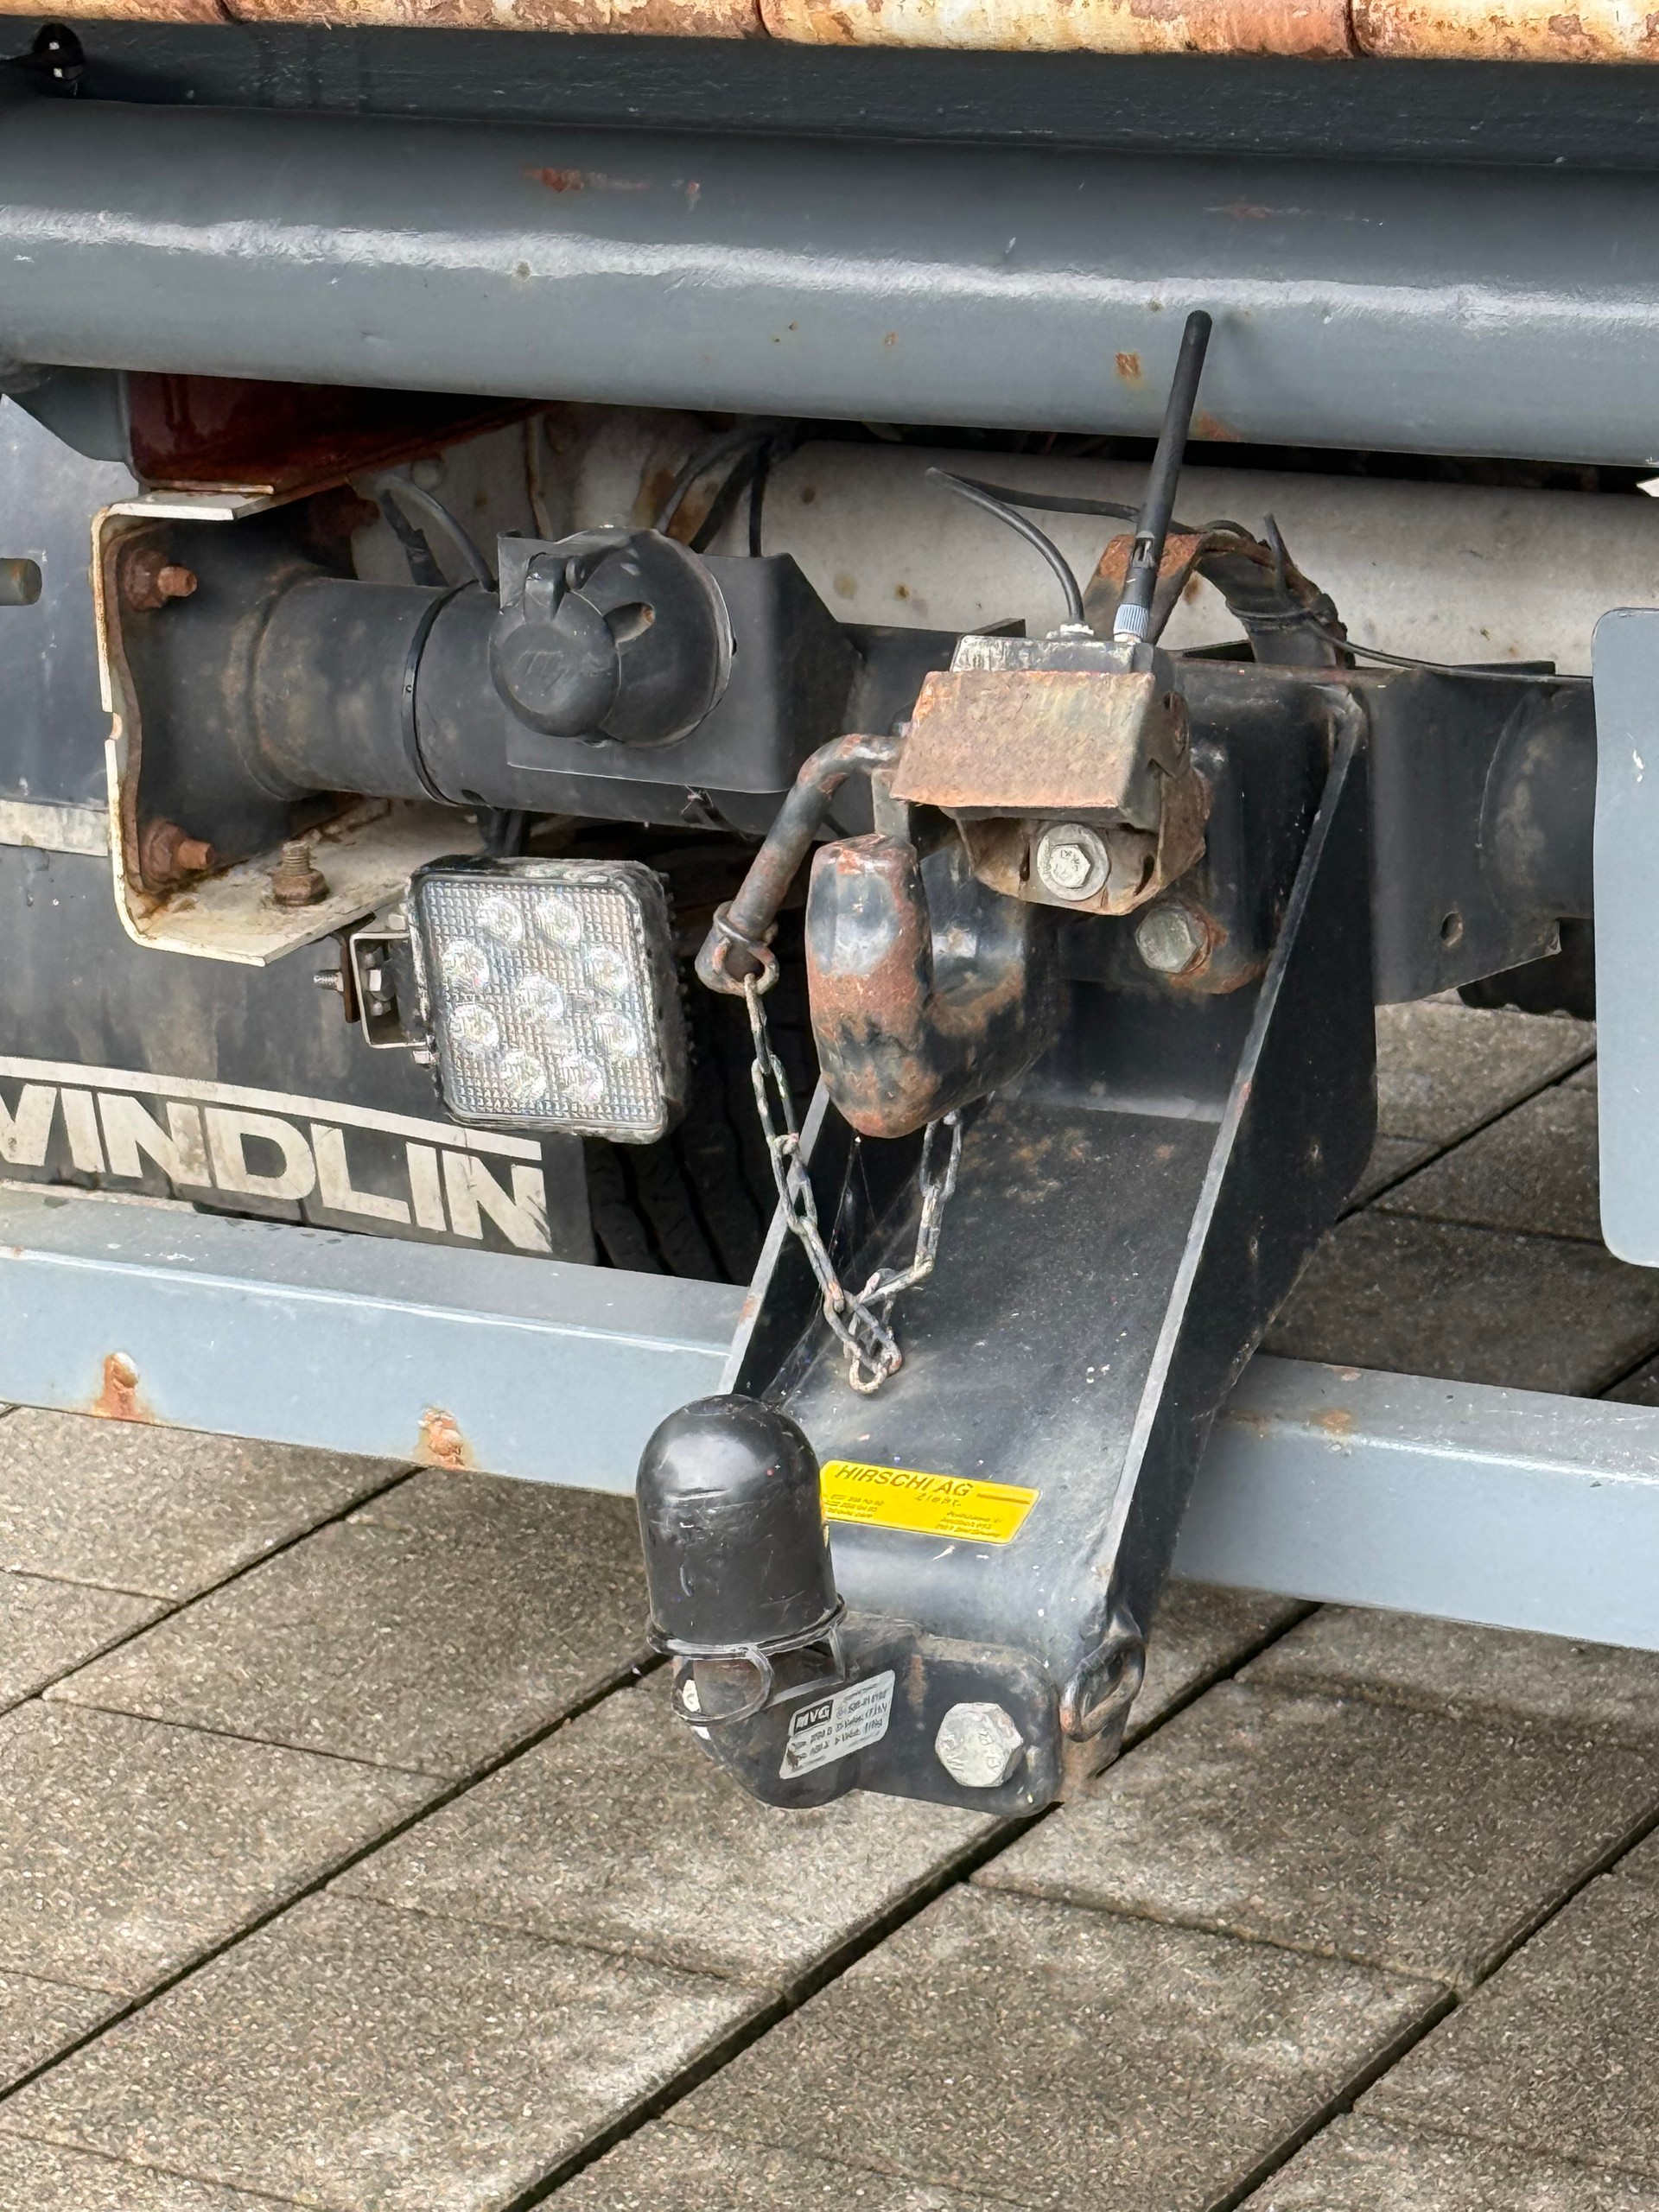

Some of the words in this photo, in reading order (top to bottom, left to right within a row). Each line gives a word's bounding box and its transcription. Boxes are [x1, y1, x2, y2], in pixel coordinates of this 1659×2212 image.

[835, 1465, 935, 1491] HIRSCHI
[933, 1479, 974, 1497] AG
[796, 1705, 830, 1730] MVG
